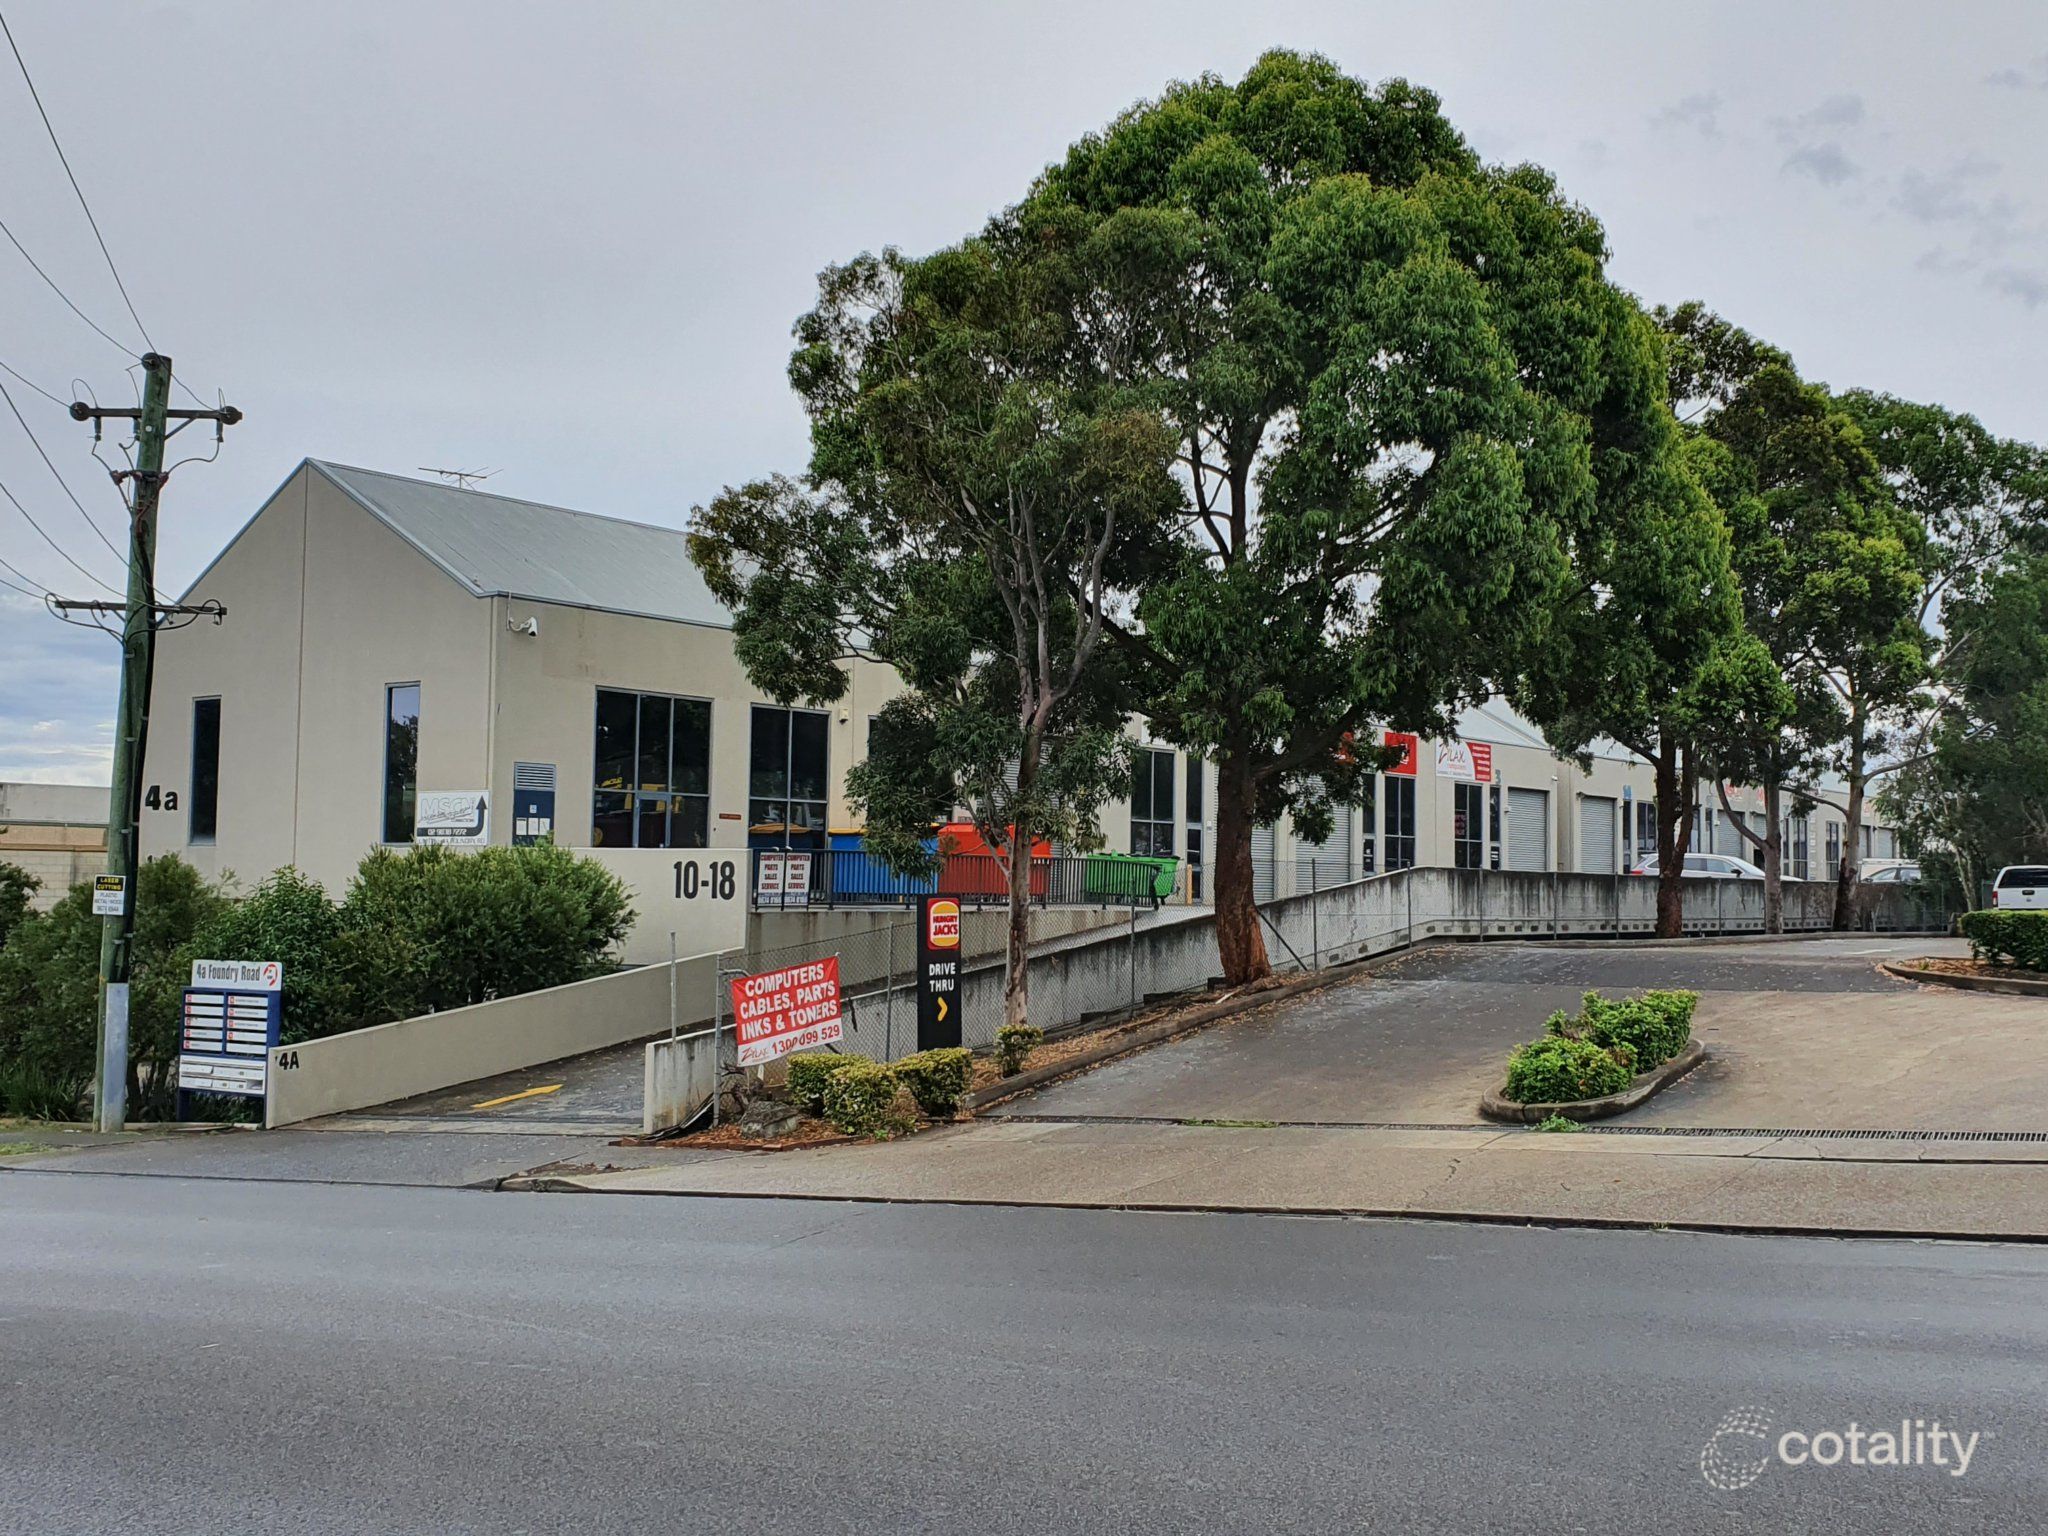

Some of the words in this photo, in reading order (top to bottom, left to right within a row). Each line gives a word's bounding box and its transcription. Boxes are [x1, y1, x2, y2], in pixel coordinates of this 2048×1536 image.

[145, 785, 179, 811] 4a
[673, 860, 736, 900] 10-18
[933, 915, 958, 923] HUNGRY
[196, 963, 206, 979] 4a
[208, 964, 240, 983] Foundry
[241, 965, 261, 981] Road
[928, 962, 956, 976] DRIVE
[745, 963, 824, 997] COMPUTERS
[929, 978, 955, 993] THRU
[740, 992, 795, 1020] CABLES,
[796, 980, 836, 1005] PARTS
[741, 1016, 772, 1041] INKS
[775, 1014, 786, 1031] &
[788, 1000, 838, 1027] TONERS
[821, 1024, 840, 1040] 529
[278, 1051, 300, 1071] 4A
